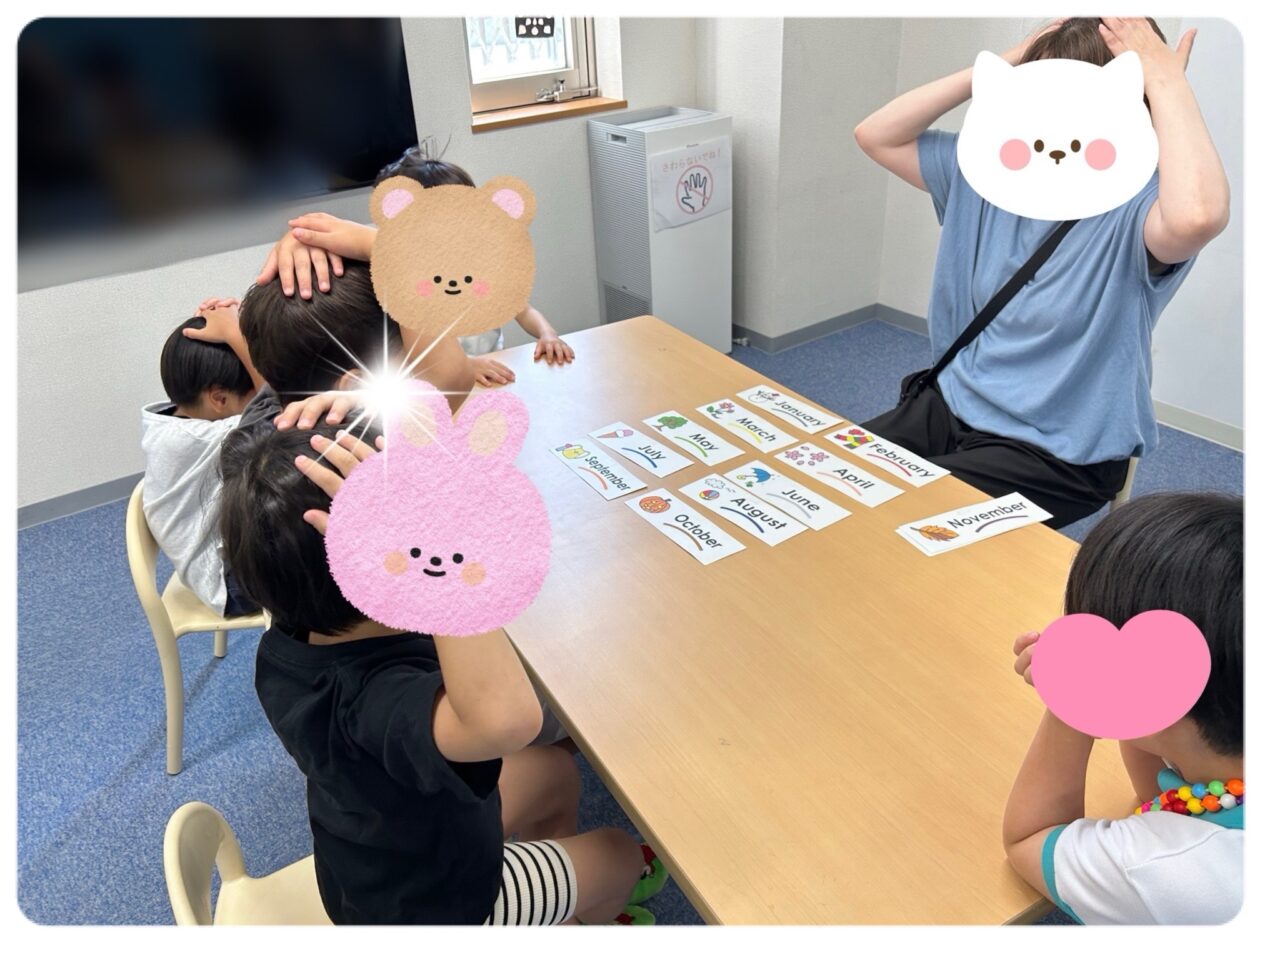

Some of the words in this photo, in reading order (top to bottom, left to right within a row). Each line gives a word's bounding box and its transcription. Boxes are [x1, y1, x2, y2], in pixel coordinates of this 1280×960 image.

[774, 400, 825, 427] January
[690, 433, 719, 452] May
[737, 417, 777, 443] March
[638, 444, 667, 461] July
[868, 443, 935, 478] February
[584, 456, 631, 492] September
[832, 467, 874, 491] April
[730, 497, 787, 530] August
[781, 488, 821, 513] June
[947, 500, 1027, 530] November
[674, 513, 723, 550] October
